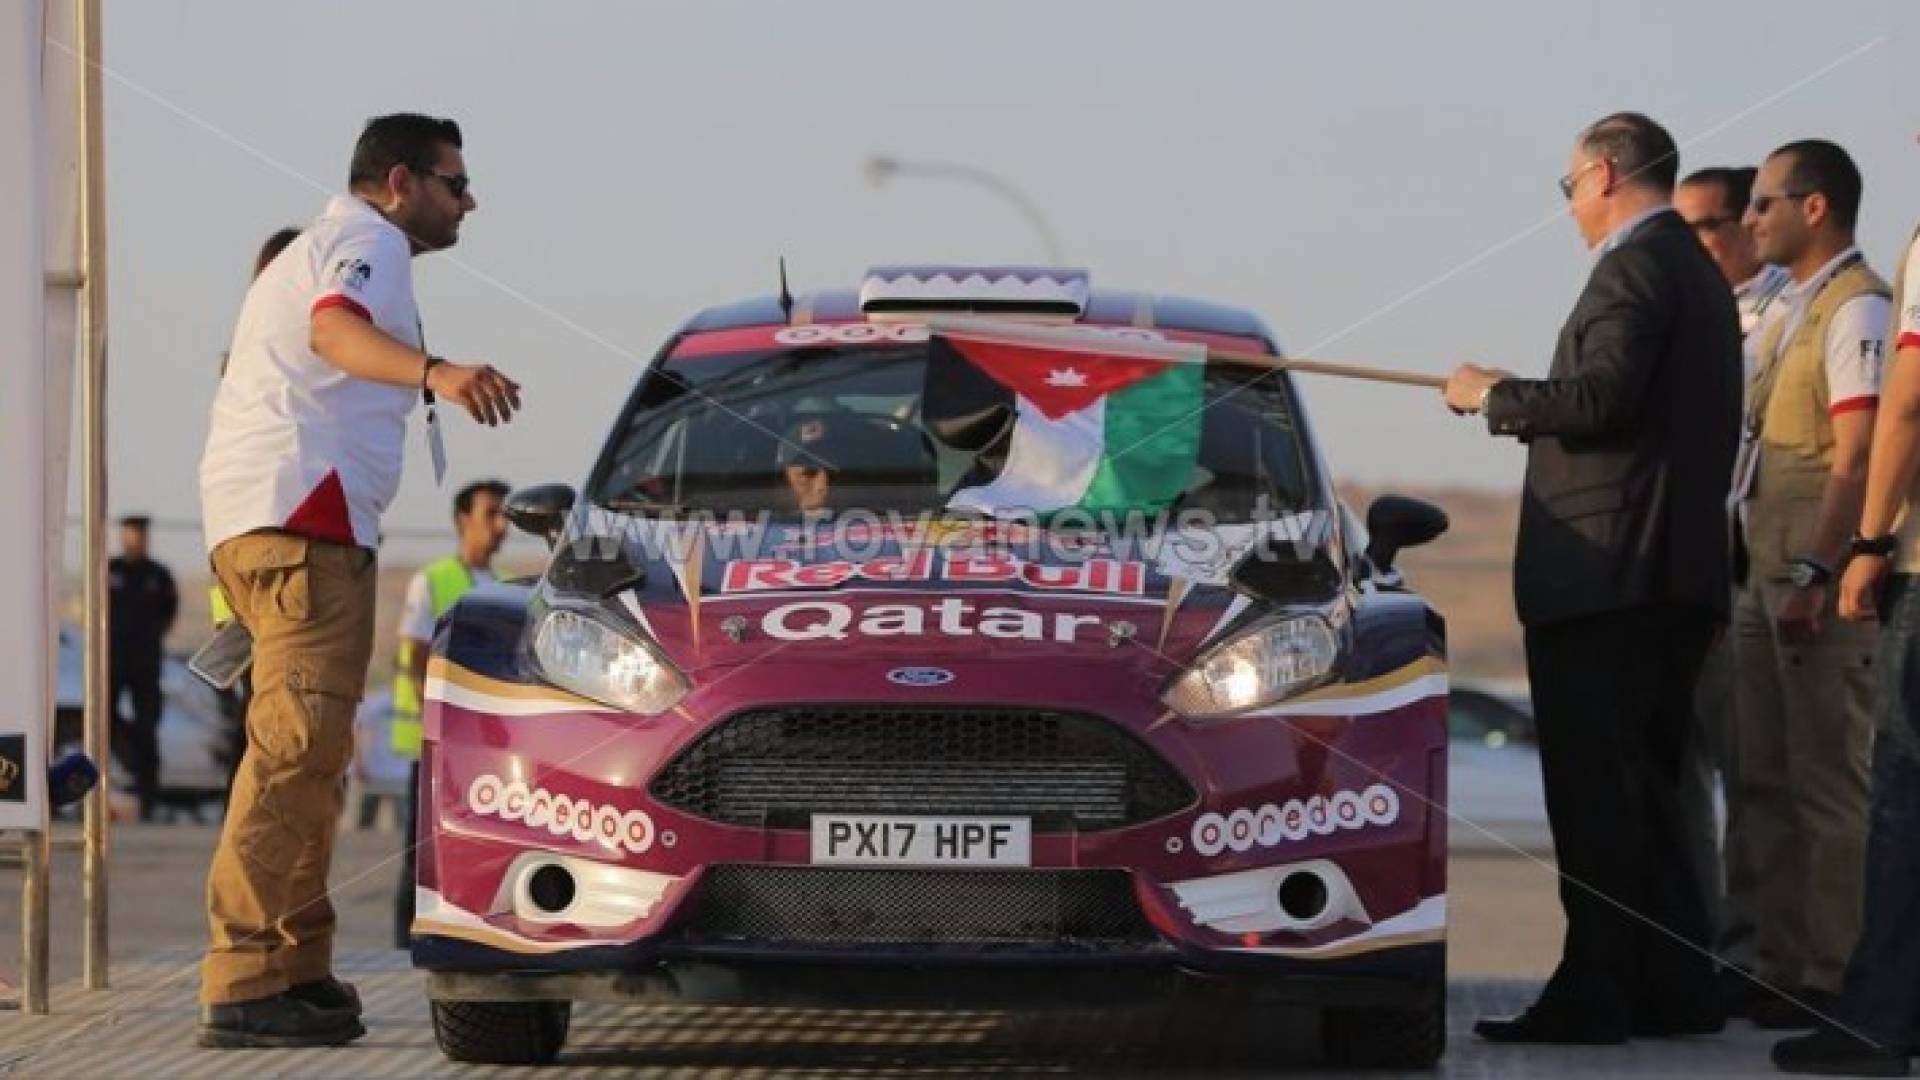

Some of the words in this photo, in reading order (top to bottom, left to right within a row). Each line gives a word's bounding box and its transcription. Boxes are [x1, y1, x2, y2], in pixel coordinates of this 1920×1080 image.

[721, 548, 931, 592] Red
[941, 549, 1146, 595] Bull
[761, 597, 1101, 643] Qatar
[828, 822, 917, 857] PX17
[934, 823, 1012, 860] HPF
[1193, 784, 1399, 855] ooredoo
